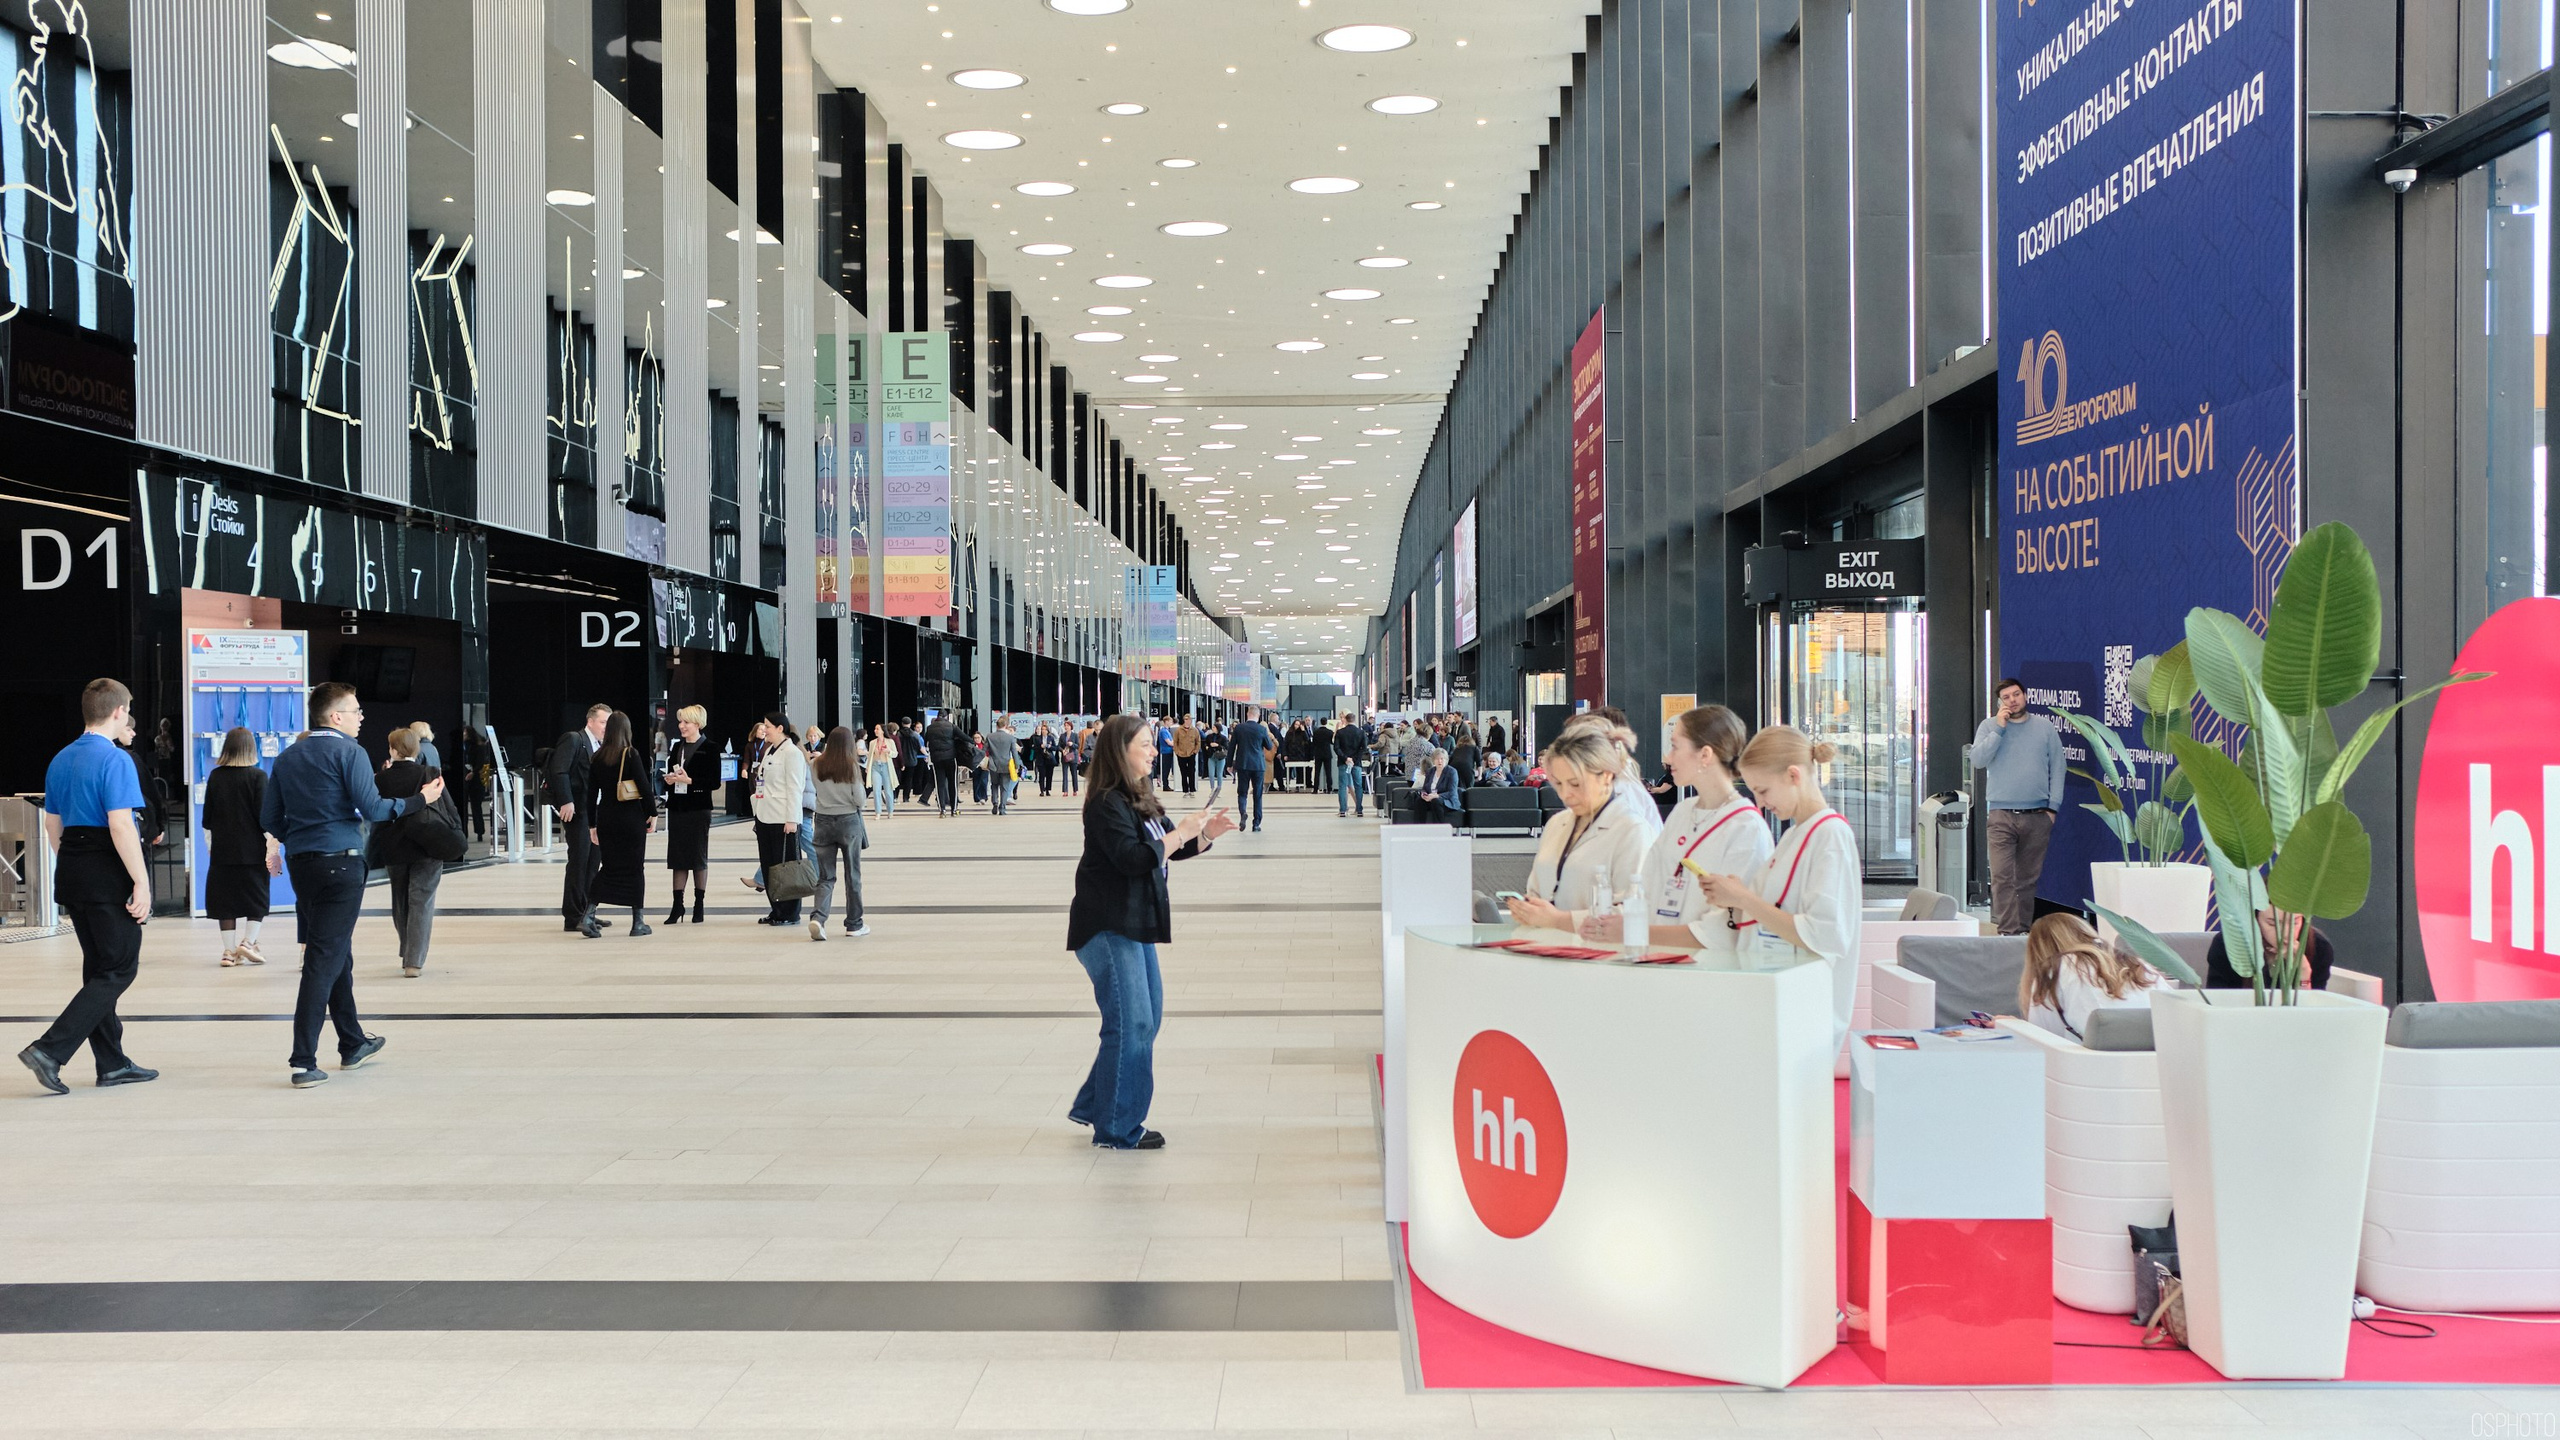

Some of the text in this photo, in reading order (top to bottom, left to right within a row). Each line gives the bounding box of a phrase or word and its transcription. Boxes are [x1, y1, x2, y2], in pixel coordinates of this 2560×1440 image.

[2017, 0, 2120, 101] УНИКАЛЬНЫЕ
[2017, 0, 2243, 184] ЭФФЕКТИВНЫЕ КОНТАКТЫ
[2017, 70, 2264, 267] ПОЗИТИВНЫЕ ВПЕЧАТЛЕНИЯ
[902, 339, 928, 380] E
[886, 388, 933, 400] E1-E12
[2016, 329, 2137, 446] 10 EXPOFORUM
[888, 431, 928, 442] F G H
[2016, 401, 2214, 514] НА СОБЫТИЙНОЙ
[888, 482, 931, 493] G20-29
[210, 492, 238, 514] Desks
[210, 514, 245, 536] Стойки
[887, 511, 931, 523] H20-29
[937, 539, 944, 548] D
[2016, 517, 2099, 575] ВЫСОТЕ!
[21, 527, 119, 591] D1
[311, 552, 324, 588] 5
[1839, 551, 1879, 568] EXIT
[364, 560, 377, 593] 6
[410, 568, 422, 600] 7
[937, 577, 944, 585] B
[1156, 568, 1167, 585] F
[1825, 571, 1895, 590] ВЫХОД
[937, 595, 944, 603] A
[579, 611, 641, 648] D2
[689, 615, 696, 637] 8
[707, 618, 714, 639] 9
[727, 621, 736, 642] 10
[1239, 644, 1247, 653] G
[2027, 688, 2081, 711] РЕКЛАМА ЗДЕСЬ
[2469, 763, 2560, 957] h
[1472, 1087, 1537, 1177] hh
